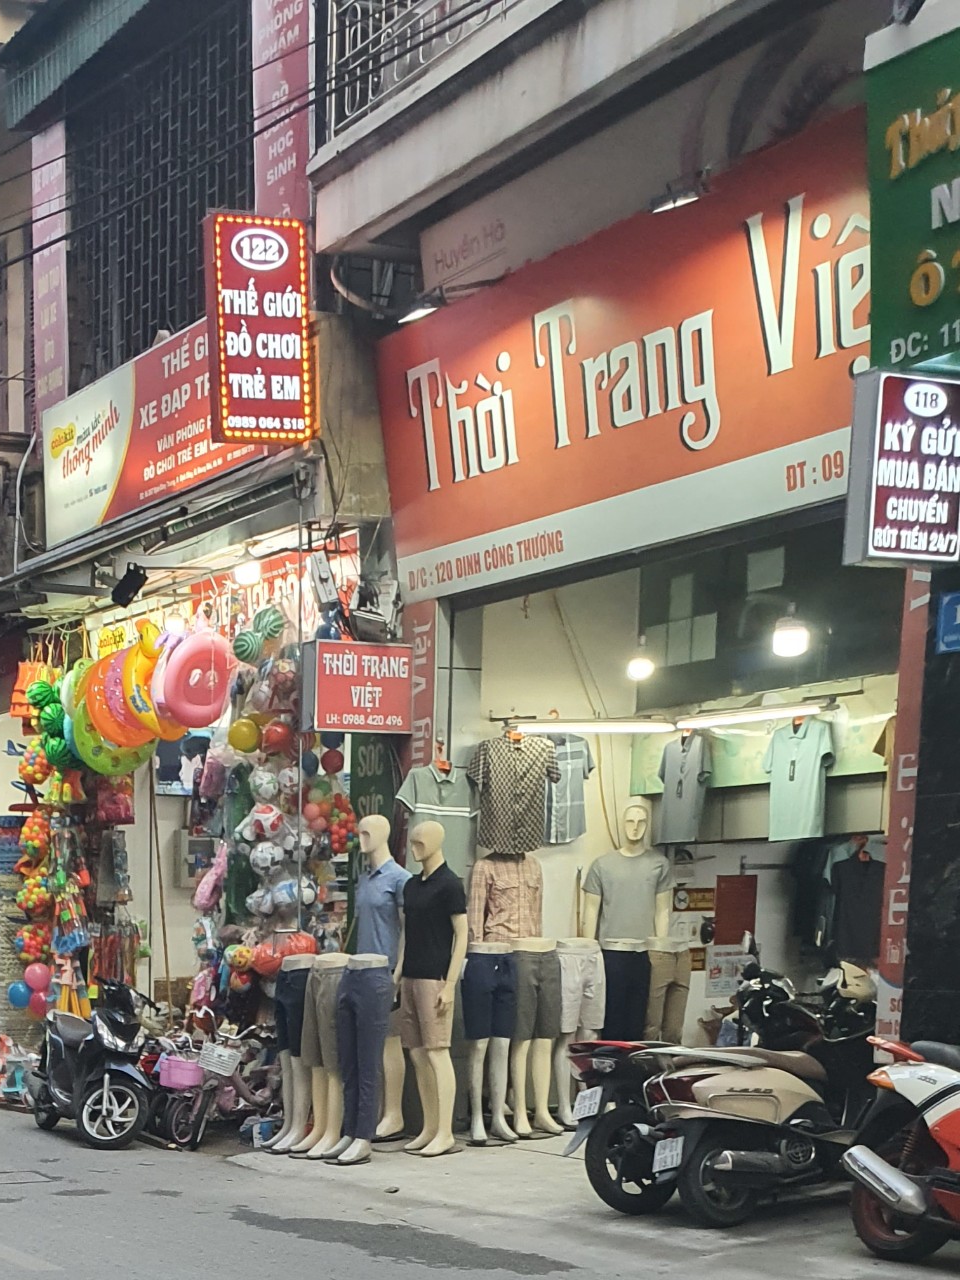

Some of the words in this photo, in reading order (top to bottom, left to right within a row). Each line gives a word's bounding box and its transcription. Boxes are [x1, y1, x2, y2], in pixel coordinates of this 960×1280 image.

[268, 130, 295, 160] HỌC
[266, 152, 297, 187] SINH
[240, 236, 281, 262] 122
[221, 276, 259, 317] THẾ
[263, 284, 303, 319] GIỚI
[161, 332, 191, 380] THẾ
[225, 318, 253, 358] ĐỒ
[255, 332, 302, 360] CHƠI
[406, 350, 520, 493] Thời
[531, 298, 722, 452] Trang
[744, 191, 871, 377] Việ
[228, 366, 267, 400] TRẺ
[270, 375, 301, 401] EM
[914, 390, 939, 409] 118
[139, 400, 158, 430] XE
[161, 381, 191, 420] ĐẠP
[883, 418, 917, 452] KÝ
[877, 457, 920, 490] MUA
[922, 456, 960, 493] BÁN
[873, 524, 899, 549] RÚT
[928, 532, 958, 554] 24/7
[435, 559, 454, 585] 120
[484, 542, 515, 572] CÔNG
[323, 650, 356, 677] THỜI
[361, 653, 409, 680] TRANG
[350, 681, 383, 713] VIỆT
[325, 713, 341, 726] LH:
[342, 713, 366, 728] 0988
[366, 714, 385, 728] 420
[385, 715, 404, 728] 496
